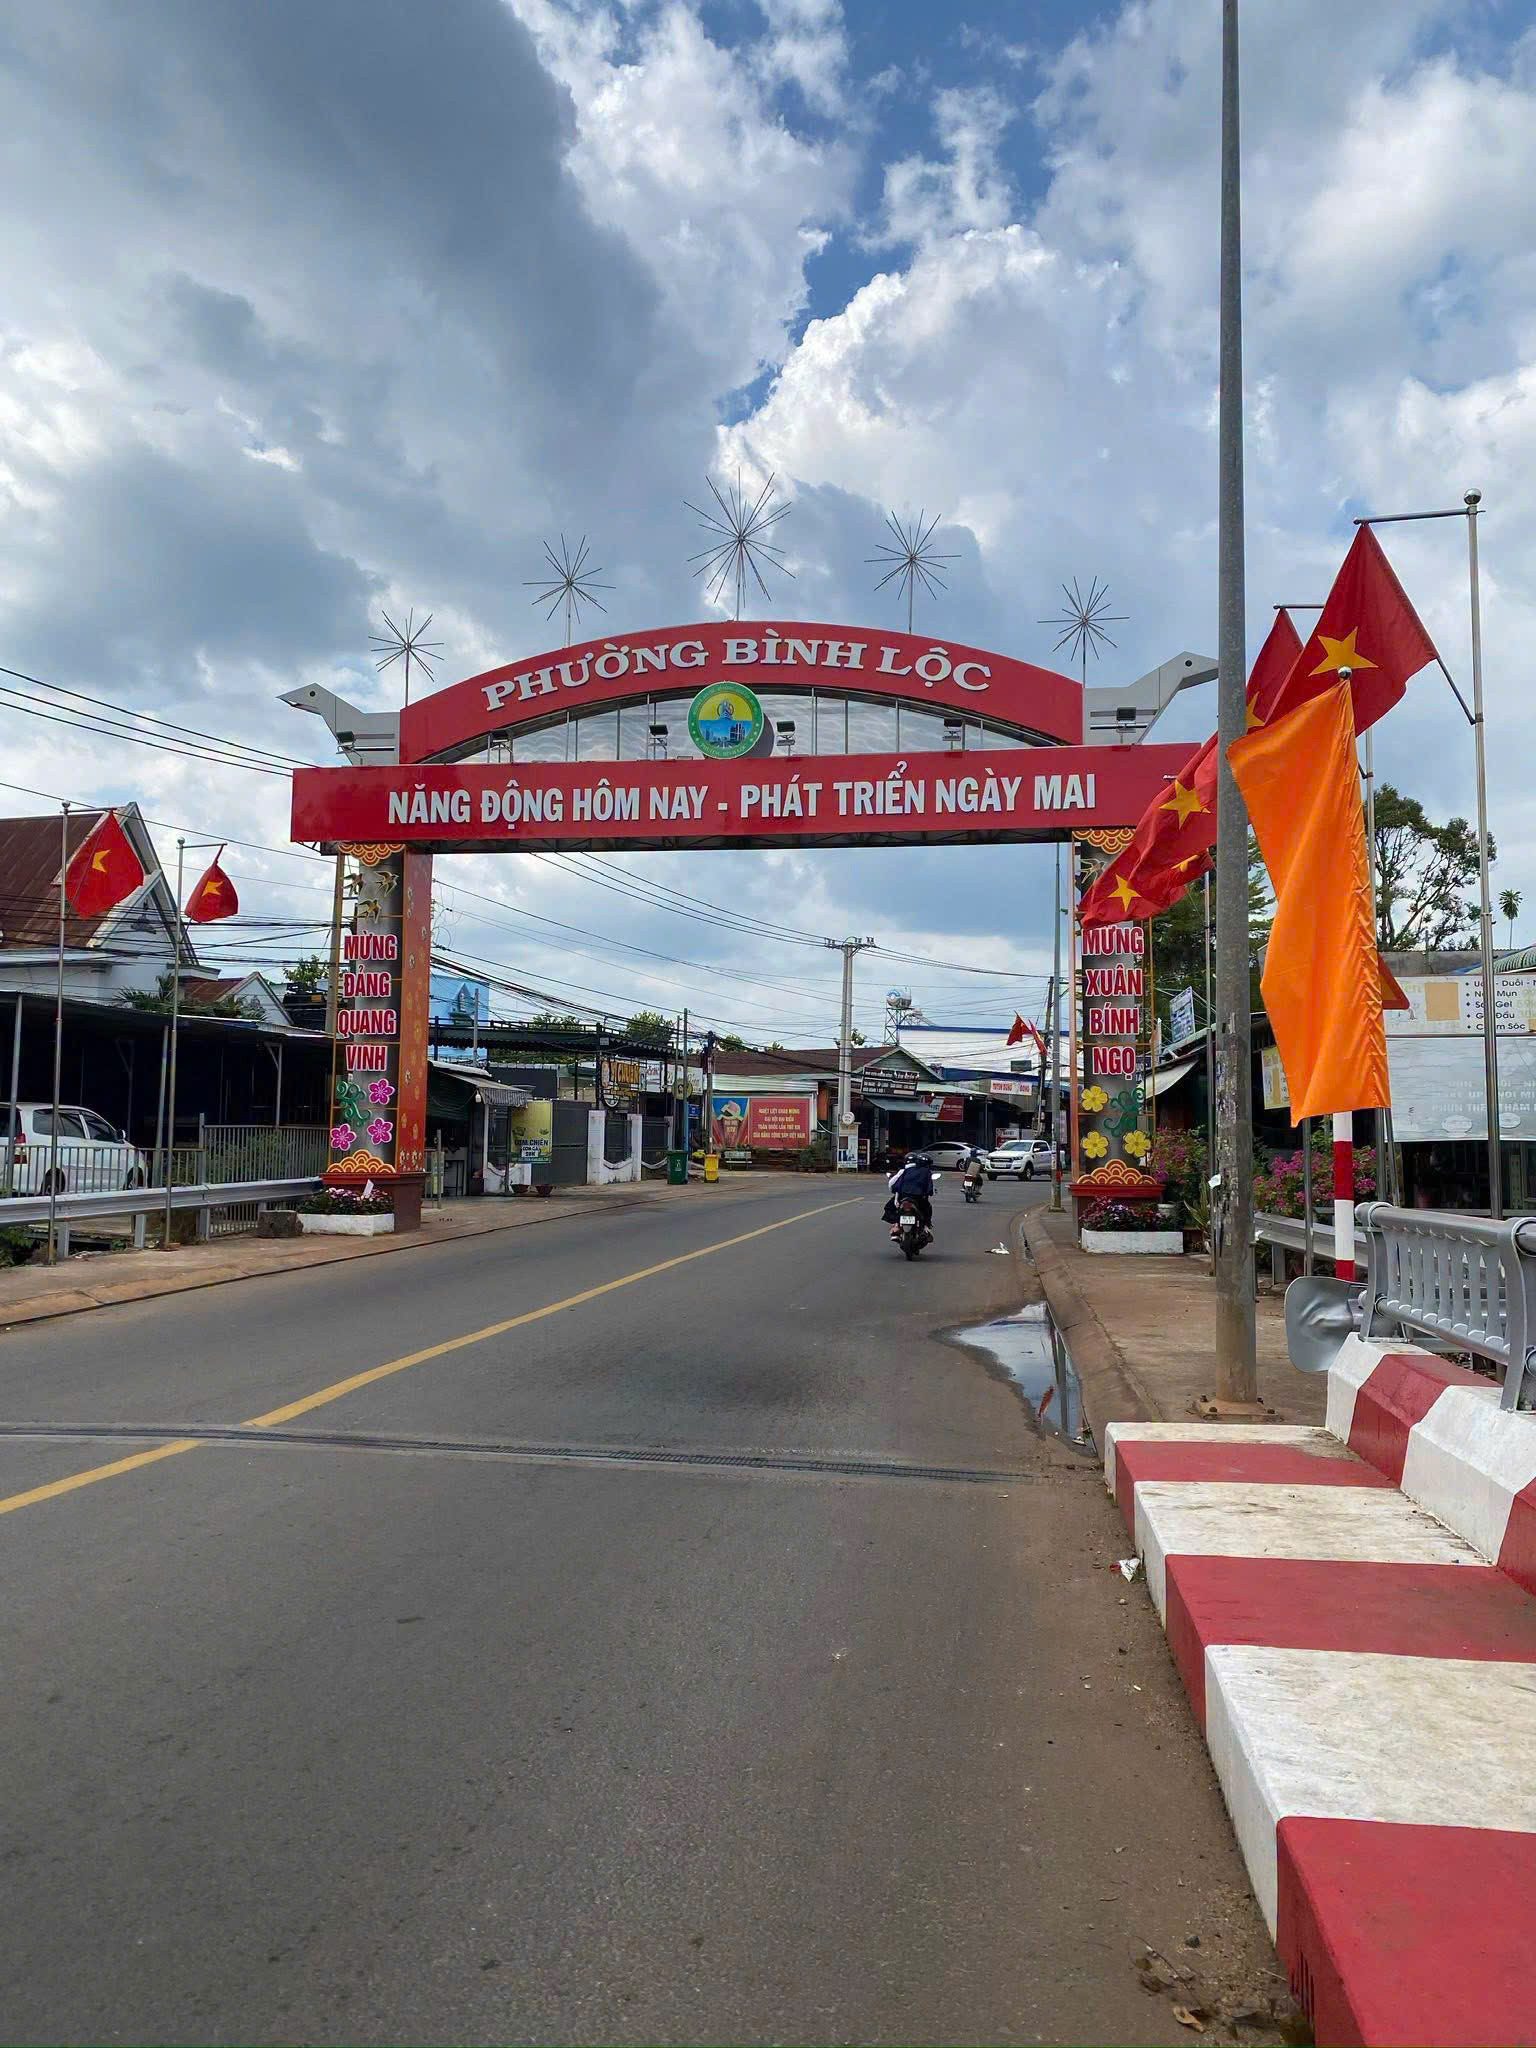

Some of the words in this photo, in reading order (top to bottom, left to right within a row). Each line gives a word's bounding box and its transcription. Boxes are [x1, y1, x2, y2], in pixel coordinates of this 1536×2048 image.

[481, 640, 709, 711] PHƯỜNG
[722, 628, 867, 669] BÌNH
[875, 647, 991, 691] LỘC
[388, 783, 471, 824] NĂNG
[480, 779, 563, 829] ĐỘNG
[573, 778, 640, 821] HÔM
[649, 785, 709, 820] NAY
[740, 774, 822, 818] PHÁT
[833, 761, 925, 816] TRIỂN
[936, 768, 1022, 813] NGÀY
[1034, 773, 1096, 811] MAI
[343, 931, 397, 960] MỪNG
[343, 965, 391, 997] ĐẢNG
[1085, 964, 1143, 996] XUÂN
[1496, 990, 1517, 998] Mụn
[338, 1009, 397, 1037] QUANG
[1090, 1003, 1139, 1034] BÍNH
[346, 1044, 387, 1072] VINH
[1092, 1047, 1136, 1080] NGỌ
